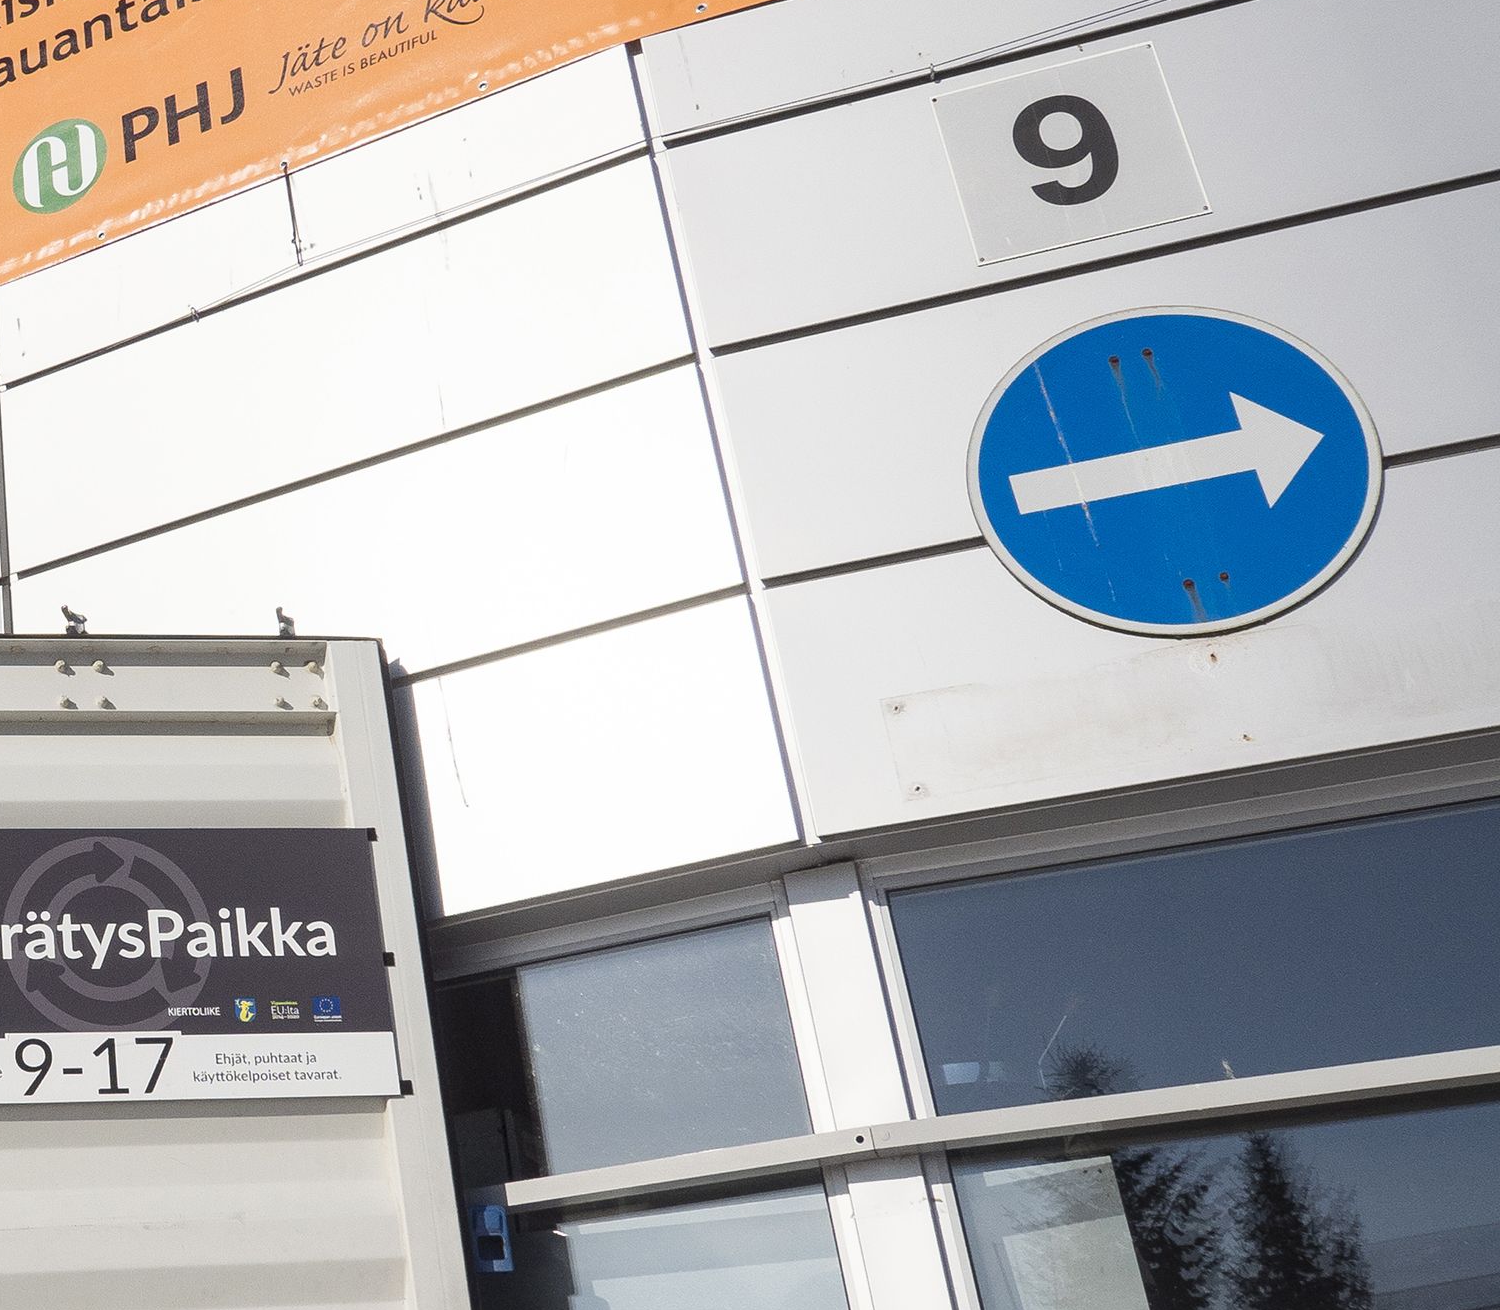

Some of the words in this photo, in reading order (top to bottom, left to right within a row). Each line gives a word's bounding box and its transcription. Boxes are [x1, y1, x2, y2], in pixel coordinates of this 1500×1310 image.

[268, 35, 347, 95] Jäte
[361, 11, 410, 48] on
[288, 69, 338, 97] WASTE
[342, 63, 356, 77] IS
[359, 30, 438, 70] BEAUTIFUL
[121, 66, 245, 164] PHJ
[1011, 94, 1120, 206] 9
[167, 1006, 221, 1017] KIERTOLIIKE
[14, 1036, 175, 1096] 9-17
[192, 1070, 291, 1084] käyttökelpoiset
[294, 1069, 342, 1081] tavarat.
[215, 1051, 251, 1066] Ehjät,
[254, 1052, 303, 1066] puhtaat
[306, 1052, 317, 1066] ja
